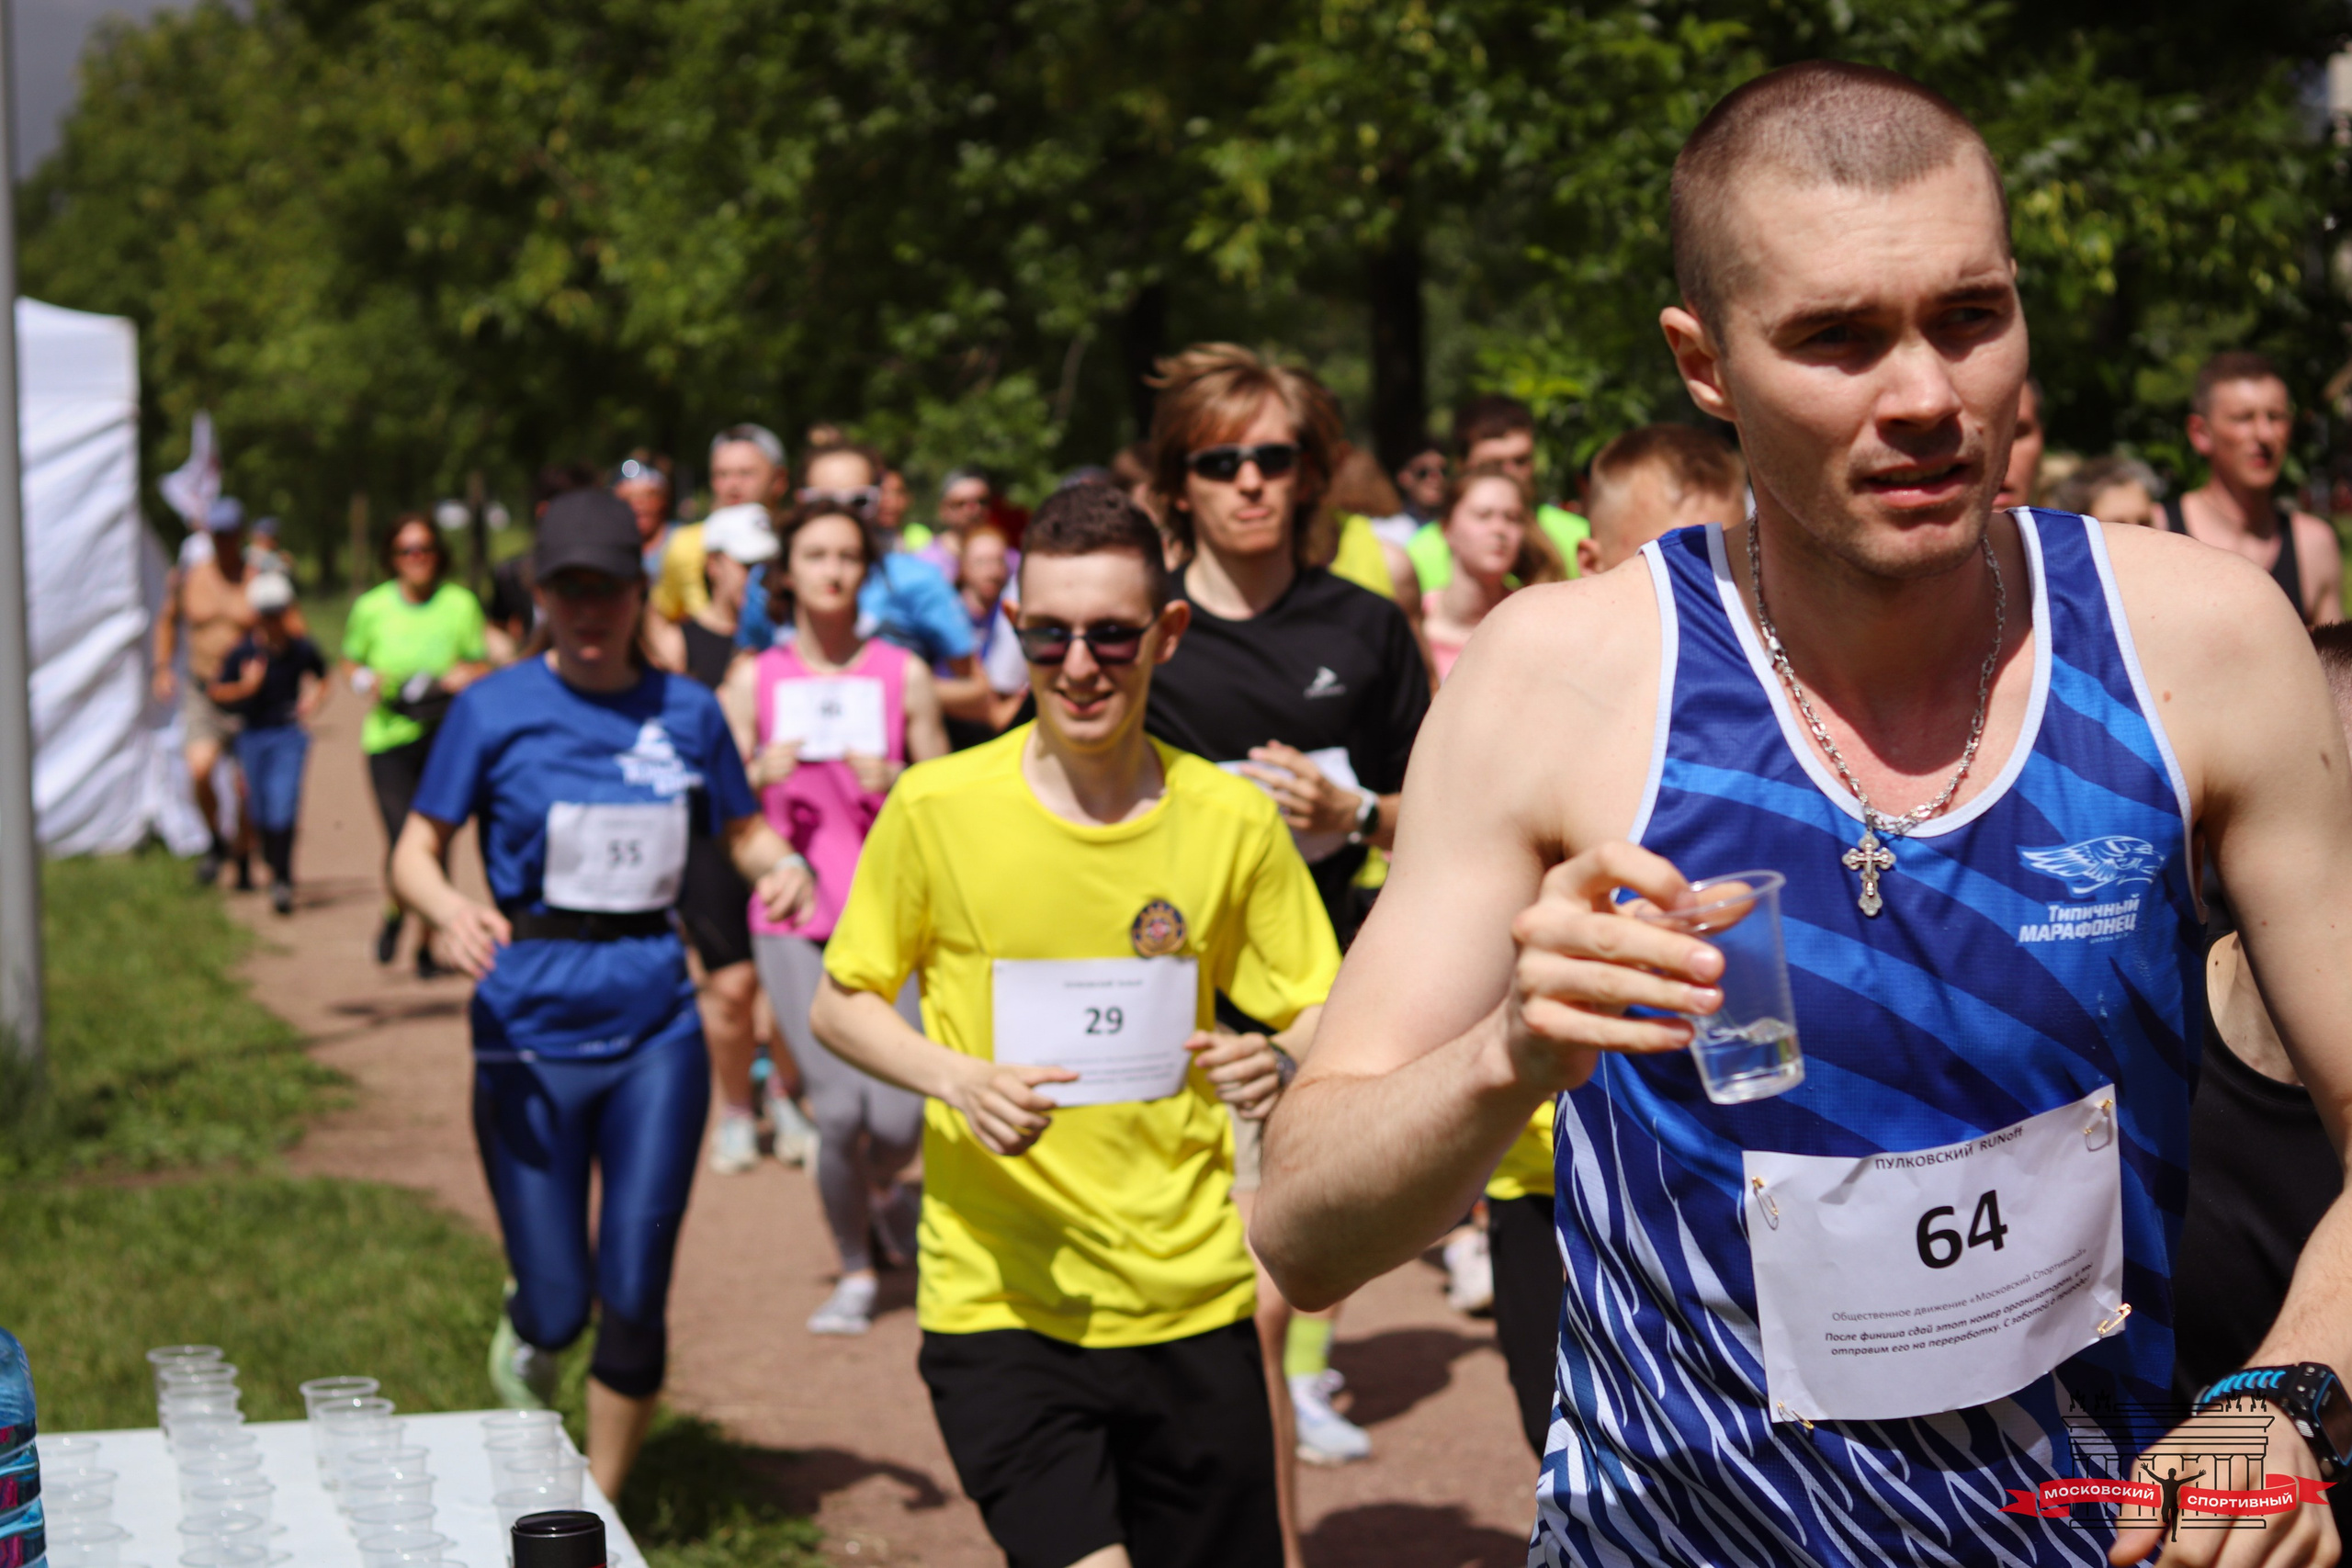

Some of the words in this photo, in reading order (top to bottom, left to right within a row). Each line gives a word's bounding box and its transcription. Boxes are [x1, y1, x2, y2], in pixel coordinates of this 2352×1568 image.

[2050, 894, 2140, 922] Типичный
[2018, 913, 2137, 943] МАРАФОНЕЦ
[1084, 1007, 1124, 1034] 29
[1875, 1144, 1973, 1169] ПУЛКОВСКИЙ
[1980, 1125, 2024, 1151] RUNoff
[1917, 1190, 2008, 1269] 64
[1832, 1308, 1911, 1322] Общественное
[1914, 1298, 1968, 1316] движение
[1970, 1275, 2031, 1302] «Московский
[1825, 1332, 1857, 1341] После
[1860, 1330, 1905, 1341] финиша
[1907, 1325, 1934, 1337] сдай
[1935, 1320, 1967, 1333] этот
[1970, 1309, 2002, 1325] номер
[1831, 1346, 1889, 1357] отправим
[1892, 1344, 1910, 1353] его
[1913, 1341, 1926, 1350] на
[1928, 1324, 2001, 1348] переработку.
[2003, 1318, 2010, 1327] С
